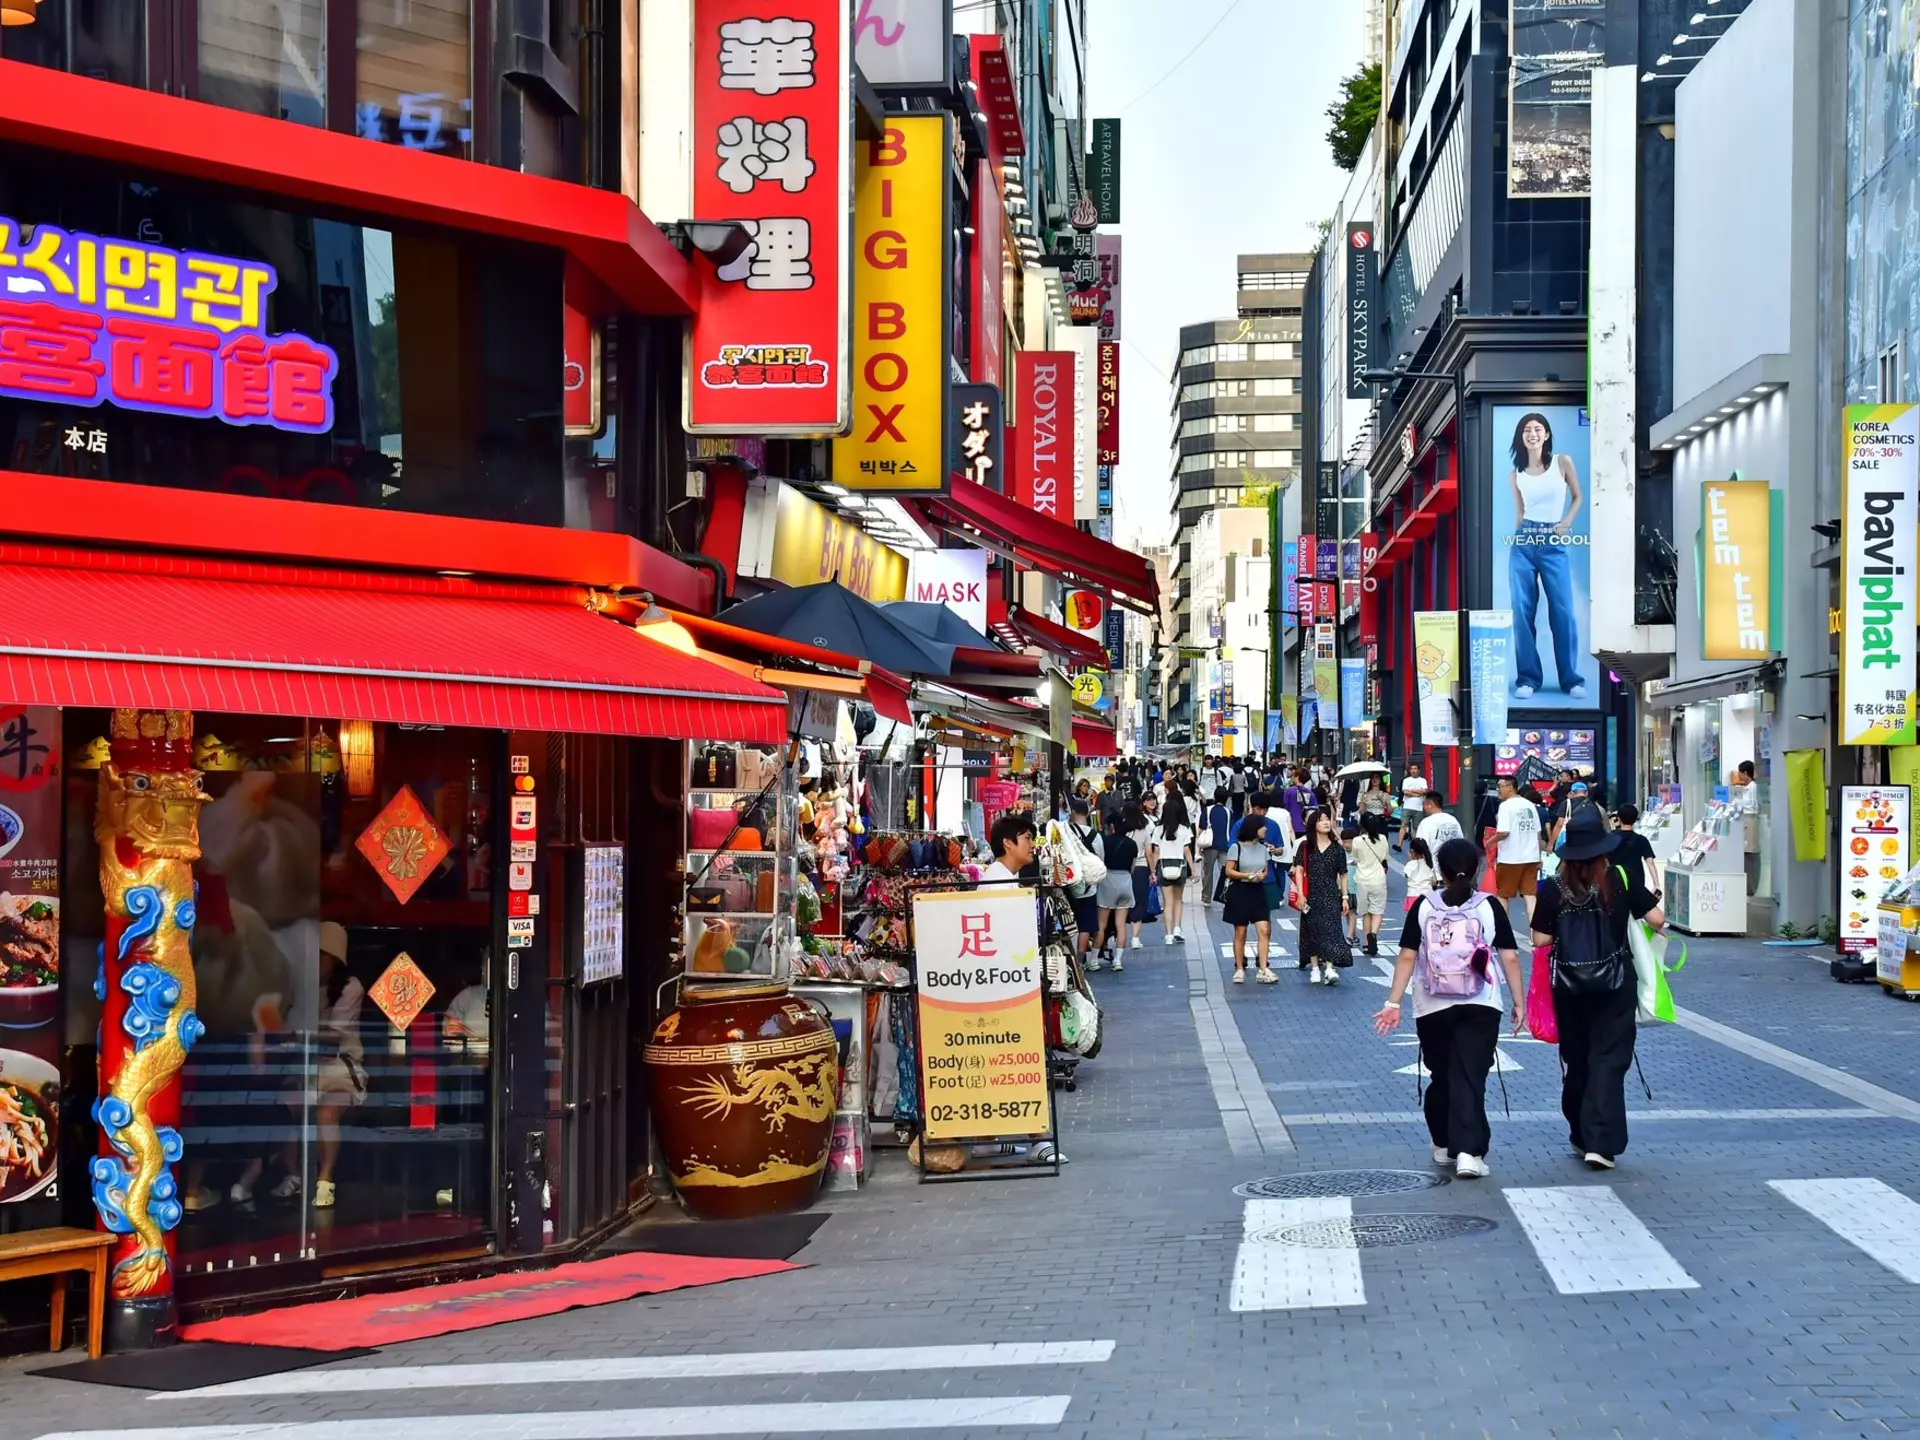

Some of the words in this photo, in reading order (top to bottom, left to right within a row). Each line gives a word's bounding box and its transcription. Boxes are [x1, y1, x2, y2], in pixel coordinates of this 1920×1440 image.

[1101, 122, 1112, 178] ARTRAVEL
[863, 127, 908, 271] BIG
[1101, 182, 1111, 219] HOME
[0, 224, 269, 333] 시면관
[1356, 254, 1366, 295] HOTEL
[1068, 294, 1099, 307] Mud
[1353, 299, 1368, 390] SKYPARK
[862, 301, 909, 443] BOX
[1102, 345, 1116, 407] 준오헤어
[1033, 363, 1057, 472] ROYAL
[1853, 422, 1890, 432] KOREA
[64, 427, 108, 454] 本店
[1852, 435, 1915, 445] COSMETICS
[1102, 450, 1118, 462] 3F
[1853, 447, 1903, 457] 70%~30%
[859, 460, 918, 475] 빅박스
[1852, 460, 1880, 470] SALE
[1502, 535, 1546, 546] WEAR
[1549, 535, 1591, 546] COOL
[1299, 537, 1307, 572] ORANGE
[1859, 491, 1905, 670] baviphat
[918, 582, 981, 603] MASK
[1109, 613, 1119, 664] MEDIHEAL
[1079, 677, 1094, 692] 光
[1885, 690, 1906, 701] 韩国
[1894, 718, 1905, 729] 折
[1697, 893, 1721, 902] Mask
[1701, 882, 1718, 893] All
[512, 922, 531, 931] VISA
[957, 912, 998, 959] 足
[944, 1033, 965, 1047] 30
[966, 1031, 1022, 1046] minute
[930, 1100, 1042, 1122] 02-318-5877
